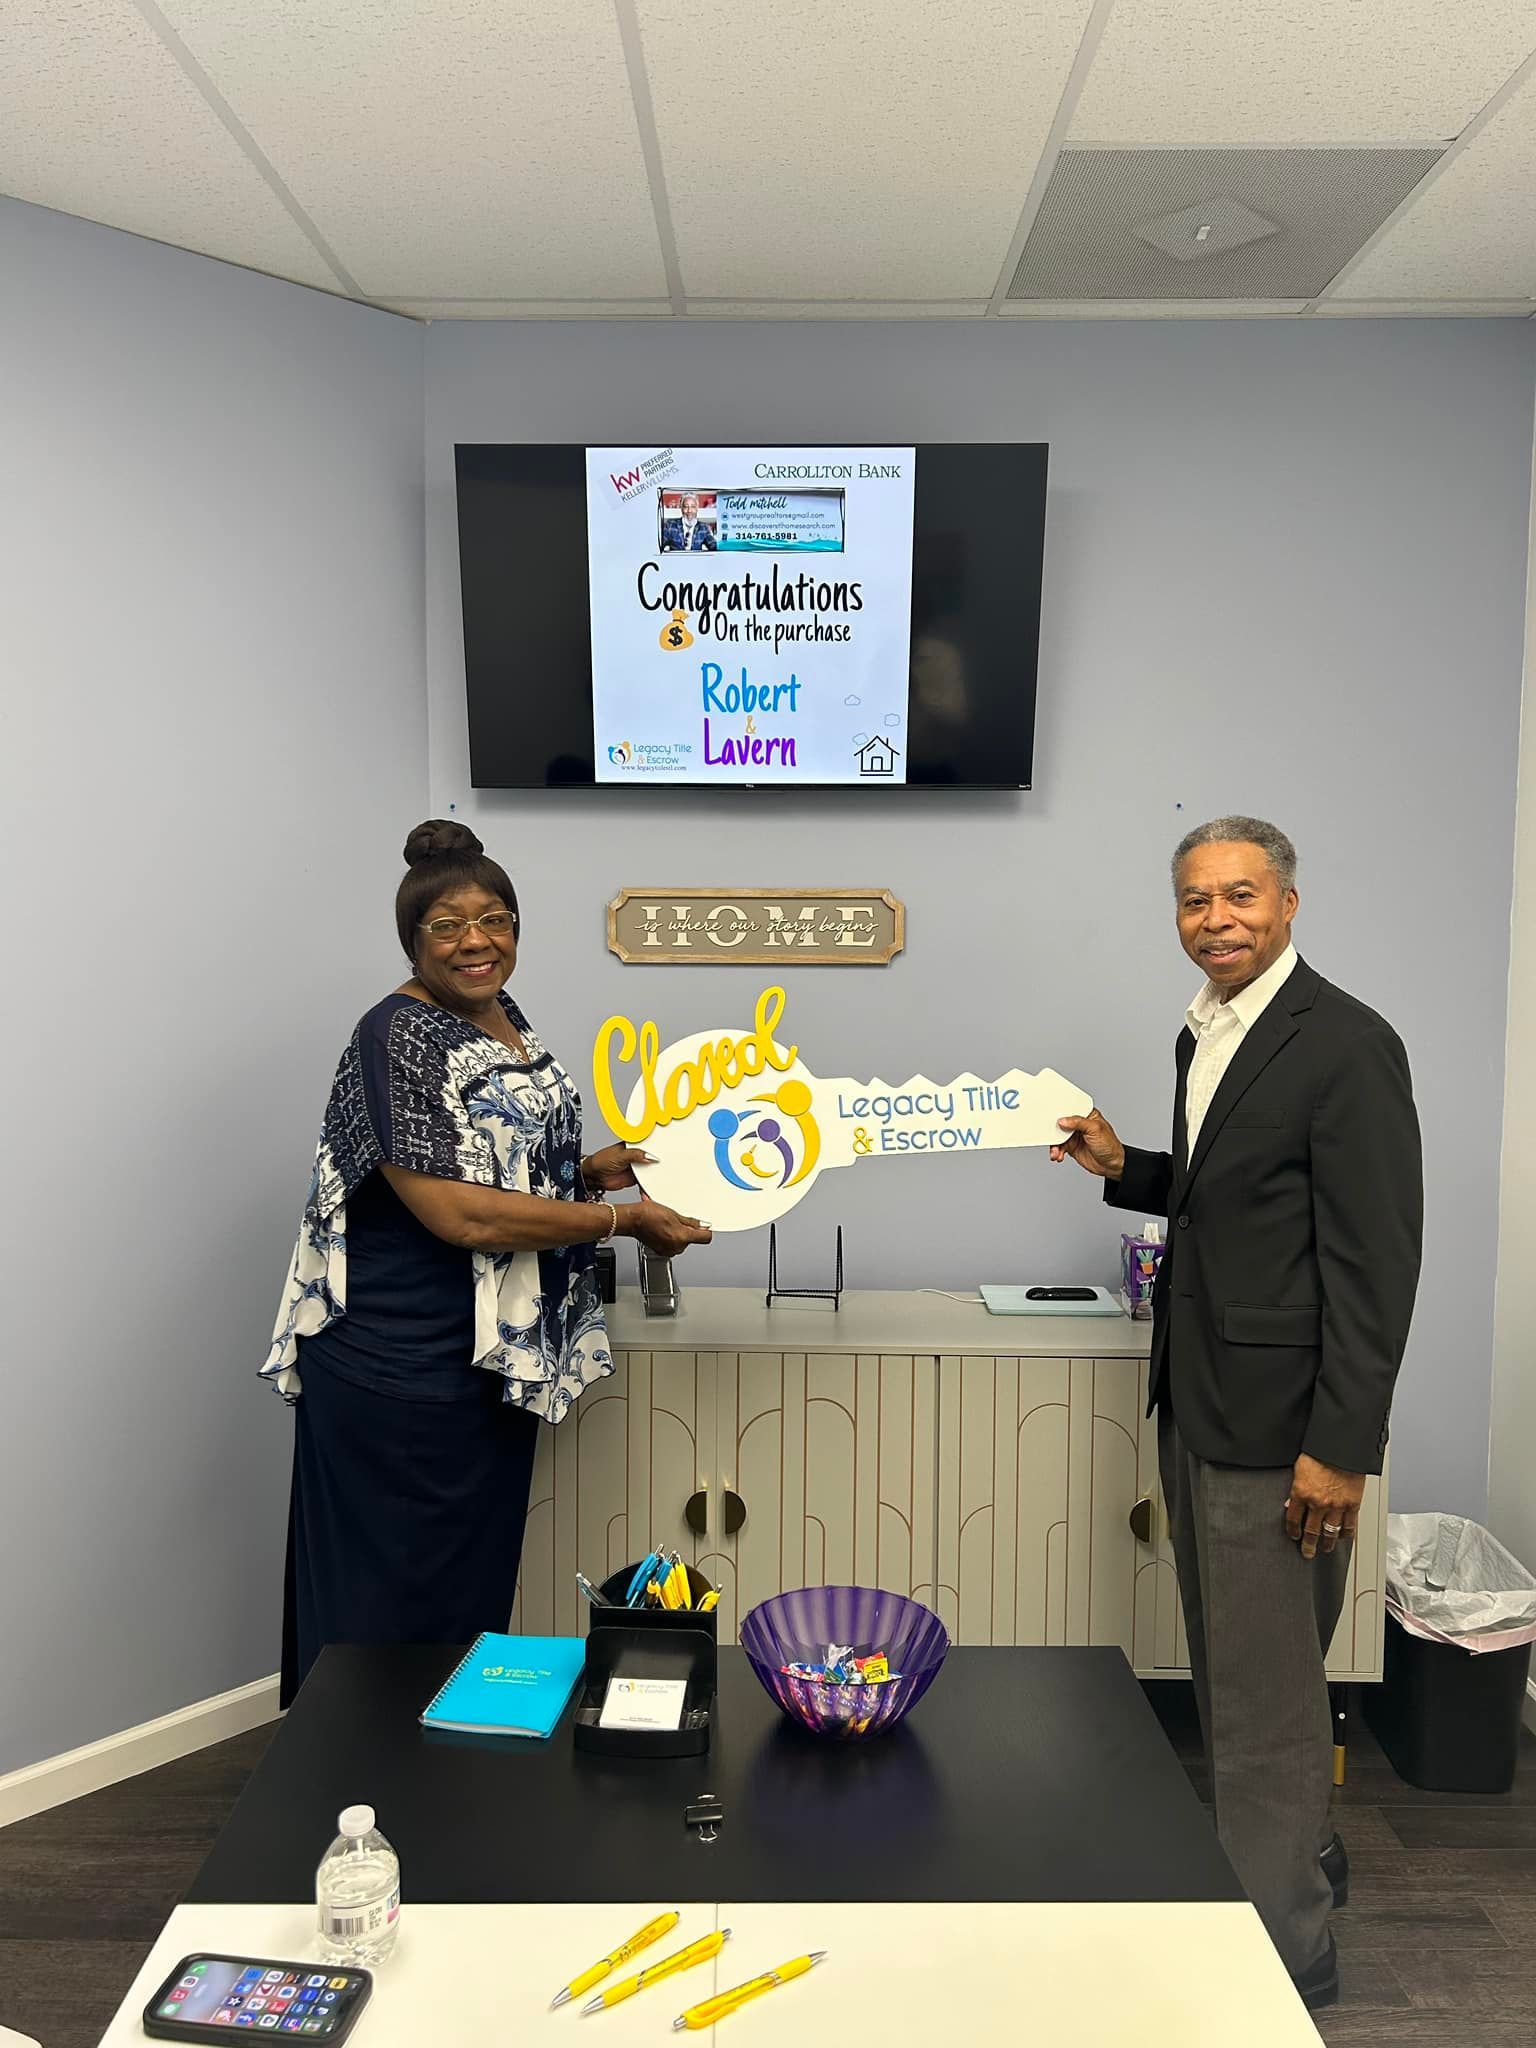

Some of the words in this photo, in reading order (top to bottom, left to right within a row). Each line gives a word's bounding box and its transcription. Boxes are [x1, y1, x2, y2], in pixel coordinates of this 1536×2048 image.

[643, 456, 674, 478] PARTNERS
[754, 463, 852, 479] CARROLLTON
[859, 463, 901, 479] BANK
[723, 496, 747, 510] Todd
[735, 532, 798, 541] 314-761-5981
[637, 561, 863, 634] Congratulations
[714, 612, 739, 642] On
[744, 614, 772, 642] the
[774, 613, 852, 655] purchase
[701, 662, 801, 713] Robert
[745, 715, 757, 734] &
[633, 743, 672, 755] Legacy
[673, 743, 693, 753] Title
[704, 717, 796, 767] Lavern
[646, 756, 680, 764] Escrow
[634, 917, 664, 932] is
[667, 915, 724, 933] where
[729, 918, 761, 932] our
[766, 914, 817, 943] story
[818, 914, 880, 942] begins
[640, 905, 877, 947] HOME
[592, 986, 799, 1143] Closed
[837, 1089, 955, 1124] Legacy
[961, 1086, 1020, 1112] Title
[852, 1127, 873, 1155] &
[881, 1126, 983, 1151] Escrow
